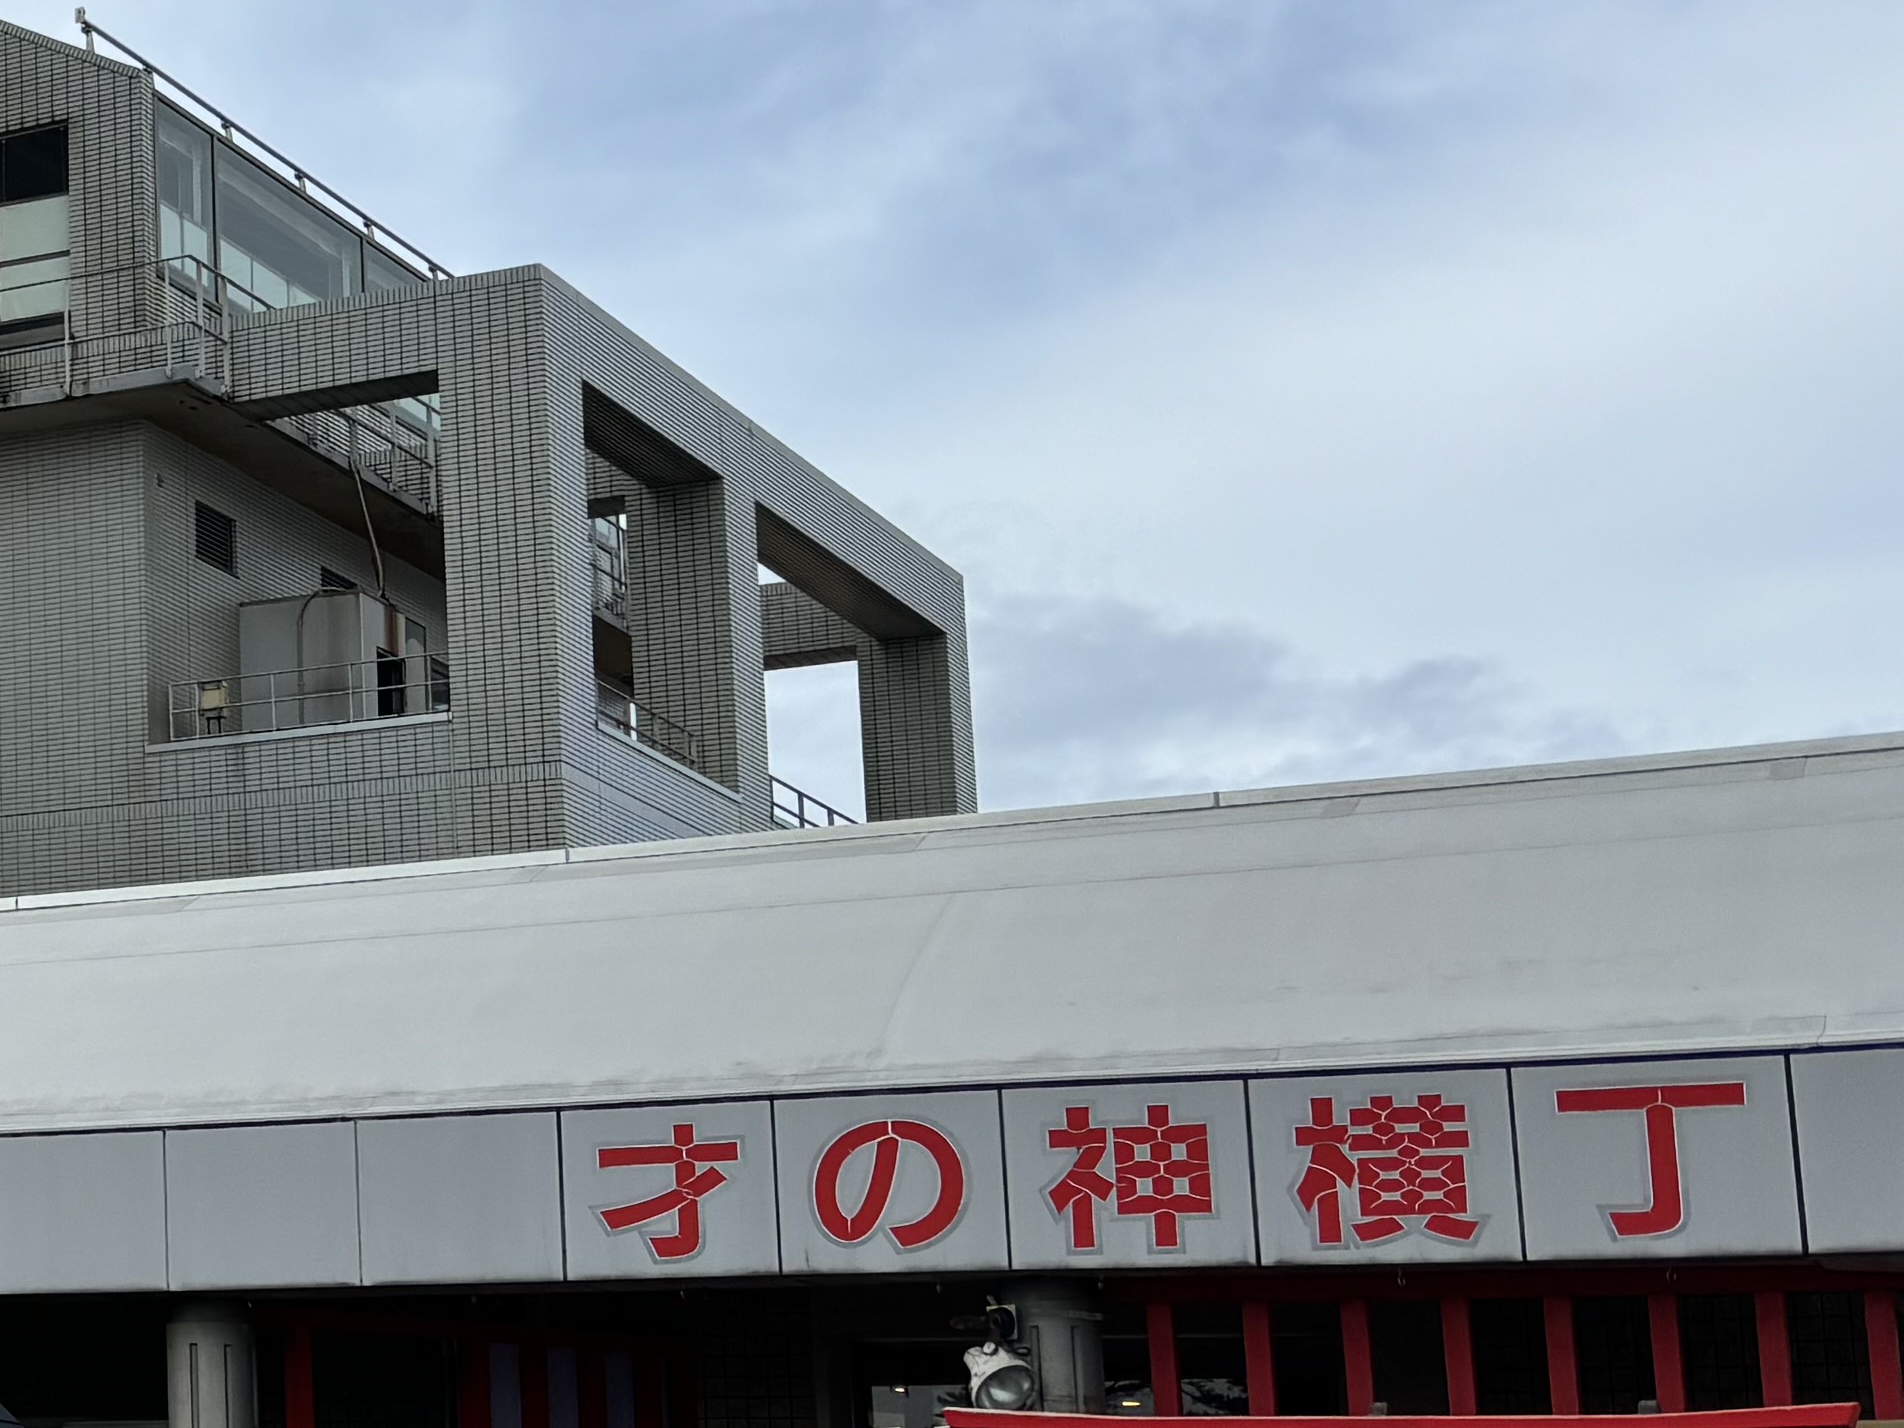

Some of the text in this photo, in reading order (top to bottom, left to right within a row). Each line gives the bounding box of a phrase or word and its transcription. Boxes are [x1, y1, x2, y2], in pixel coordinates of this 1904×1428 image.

[592, 1080, 1749, 1262] 才の神横丁
